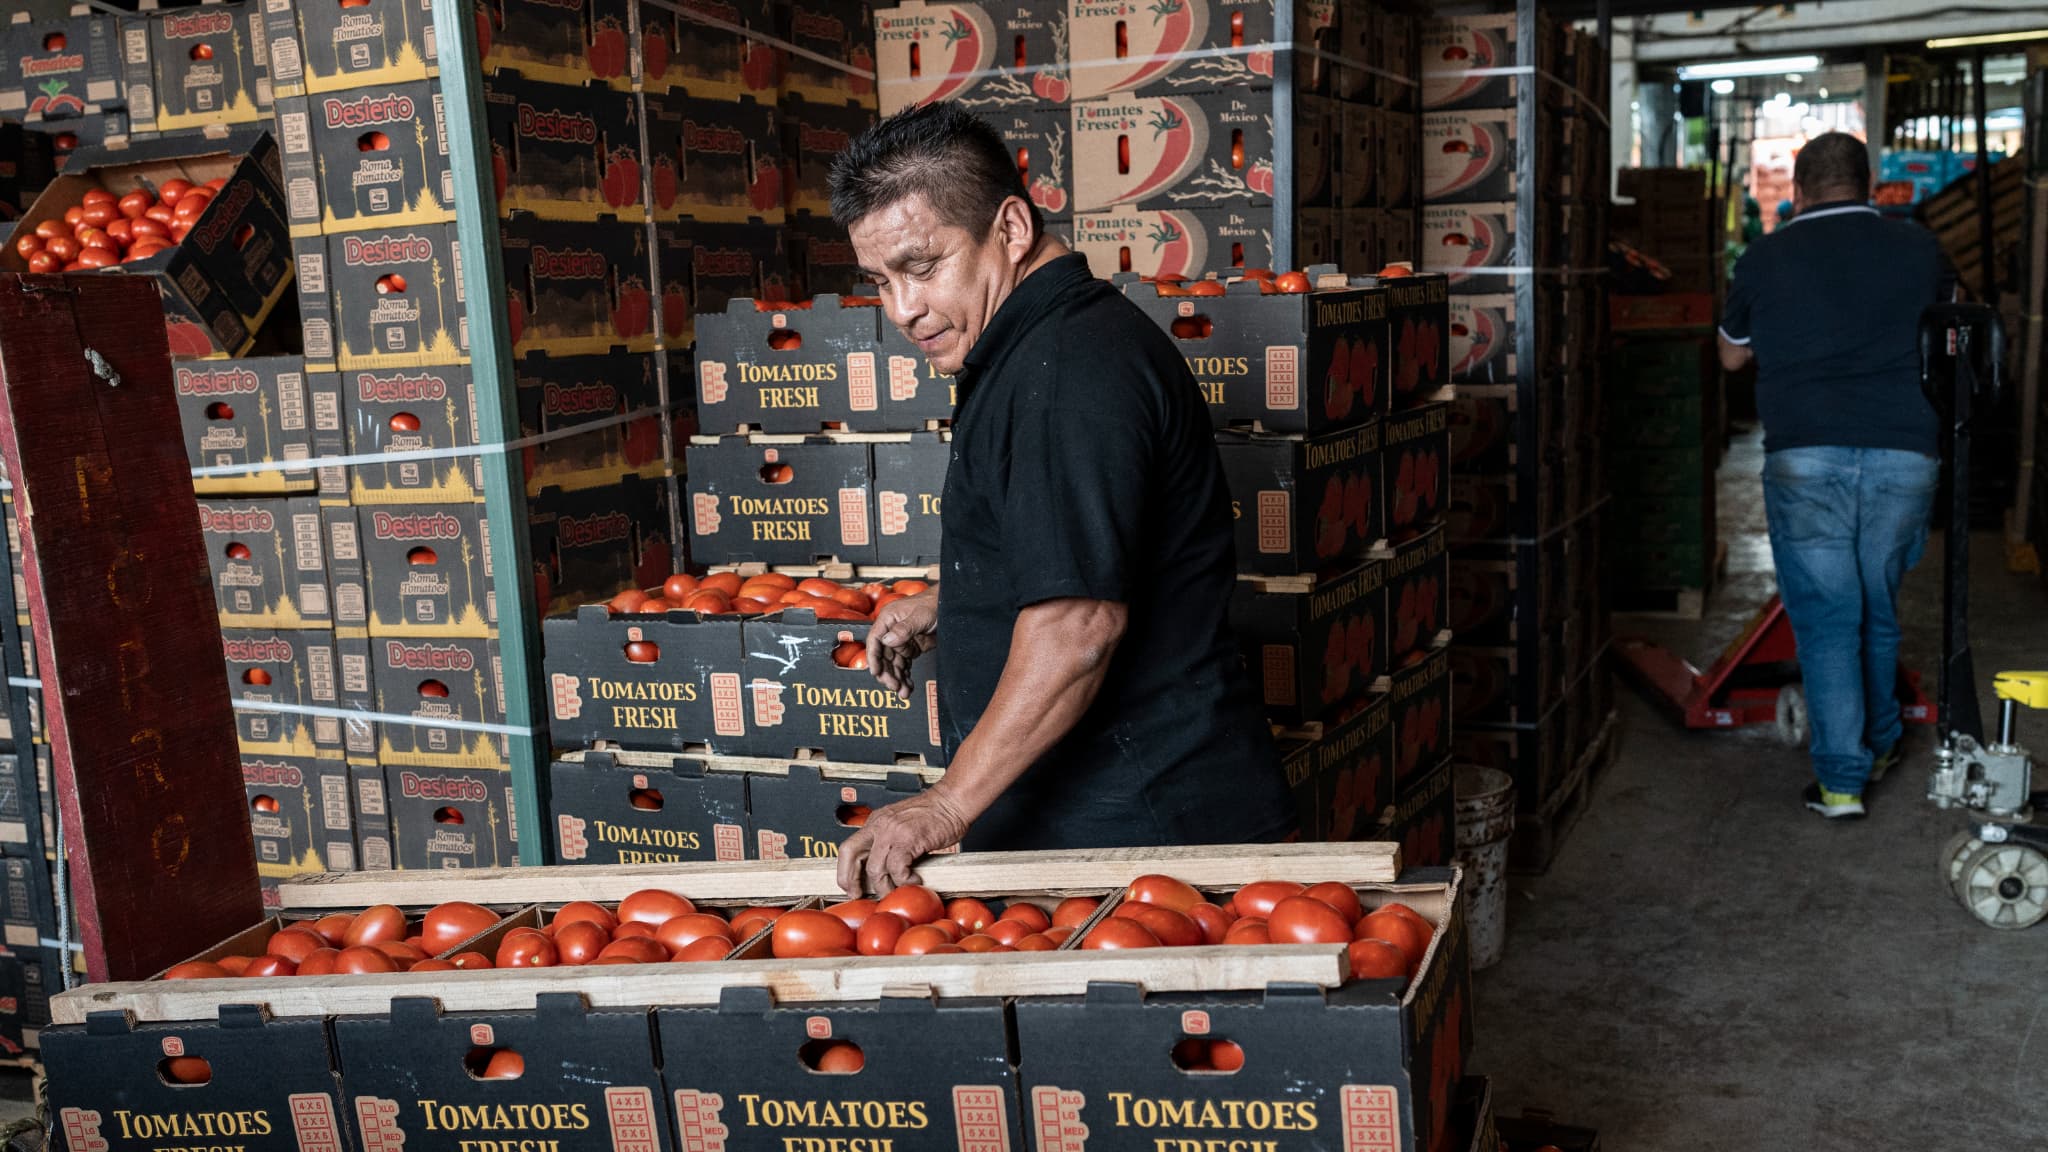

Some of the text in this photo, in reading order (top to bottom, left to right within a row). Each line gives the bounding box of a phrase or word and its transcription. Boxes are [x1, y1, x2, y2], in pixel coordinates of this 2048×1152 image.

[1018, 8, 1032, 18] De
[1075, 3, 1136, 18] Frescos
[164, 11, 232, 38] Desierto
[342, 14, 372, 27] Roma
[875, 16, 936, 29] Tomates
[334, 25, 382, 41] Tomatoes
[21, 54, 84, 78] Tomatoes
[324, 94, 414, 127] Desierto
[1076, 105, 1143, 118] Tomates
[1231, 100, 1247, 111] De
[518, 103, 596, 144] Desierto
[1014, 118, 1029, 129] De
[1077, 118, 1136, 131] Frescos
[360, 160, 392, 173] Roma
[353, 170, 400, 185] Tomatoes
[1077, 217, 1143, 230] Tomates
[1230, 214, 1245, 225] De
[1076, 230, 1136, 242] Frescos
[344, 233, 432, 266] Desierto
[531, 245, 608, 279] Desierto
[379, 298, 408, 311] Roma
[370, 309, 418, 323] Tomatoes
[177, 367, 259, 395] Desierto
[737, 362, 838, 384] TOMATOES
[358, 373, 446, 402] Desierto
[545, 379, 616, 415] Desierto
[759, 387, 820, 408] FRESH
[392, 435, 422, 447] Roma
[1304, 437, 1356, 471] TOMATOES
[729, 495, 830, 517] TOMATOES
[198, 504, 274, 532] Deserto
[373, 511, 461, 540] Desierto
[558, 510, 631, 548] Desierto
[752, 520, 811, 541] FRESH
[409, 572, 439, 584] Roma
[401, 582, 449, 595] Tomatoes
[387, 641, 473, 671] Desierto
[588, 677, 697, 702] TOMATOES
[792, 683, 911, 710] TOMATOES
[421, 701, 450, 713] Roma
[612, 706, 678, 729] FRESH
[818, 713, 889, 738] FRESH
[242, 761, 302, 788] esierto
[401, 771, 487, 801] Desierto
[252, 825, 289, 838] omatoes
[435, 829, 465, 842] Roma
[594, 820, 700, 850] TOMATOES
[428, 840, 474, 854] Tomatoes
[1061, 1096, 1080, 1104] XLG
[417, 1099, 590, 1130] TOMATOES
[702, 1112, 714, 1120] LG
[738, 1094, 929, 1129] TOMATOES
[1063, 1111, 1076, 1120] LG
[1108, 1092, 1318, 1131] TOMATOES
[113, 1110, 272, 1139] TOMATOES
[704, 1127, 723, 1135] MED
[1064, 1127, 1084, 1135] MED
[707, 1142, 720, 1150] SM
[1066, 1143, 1080, 1151] SM
